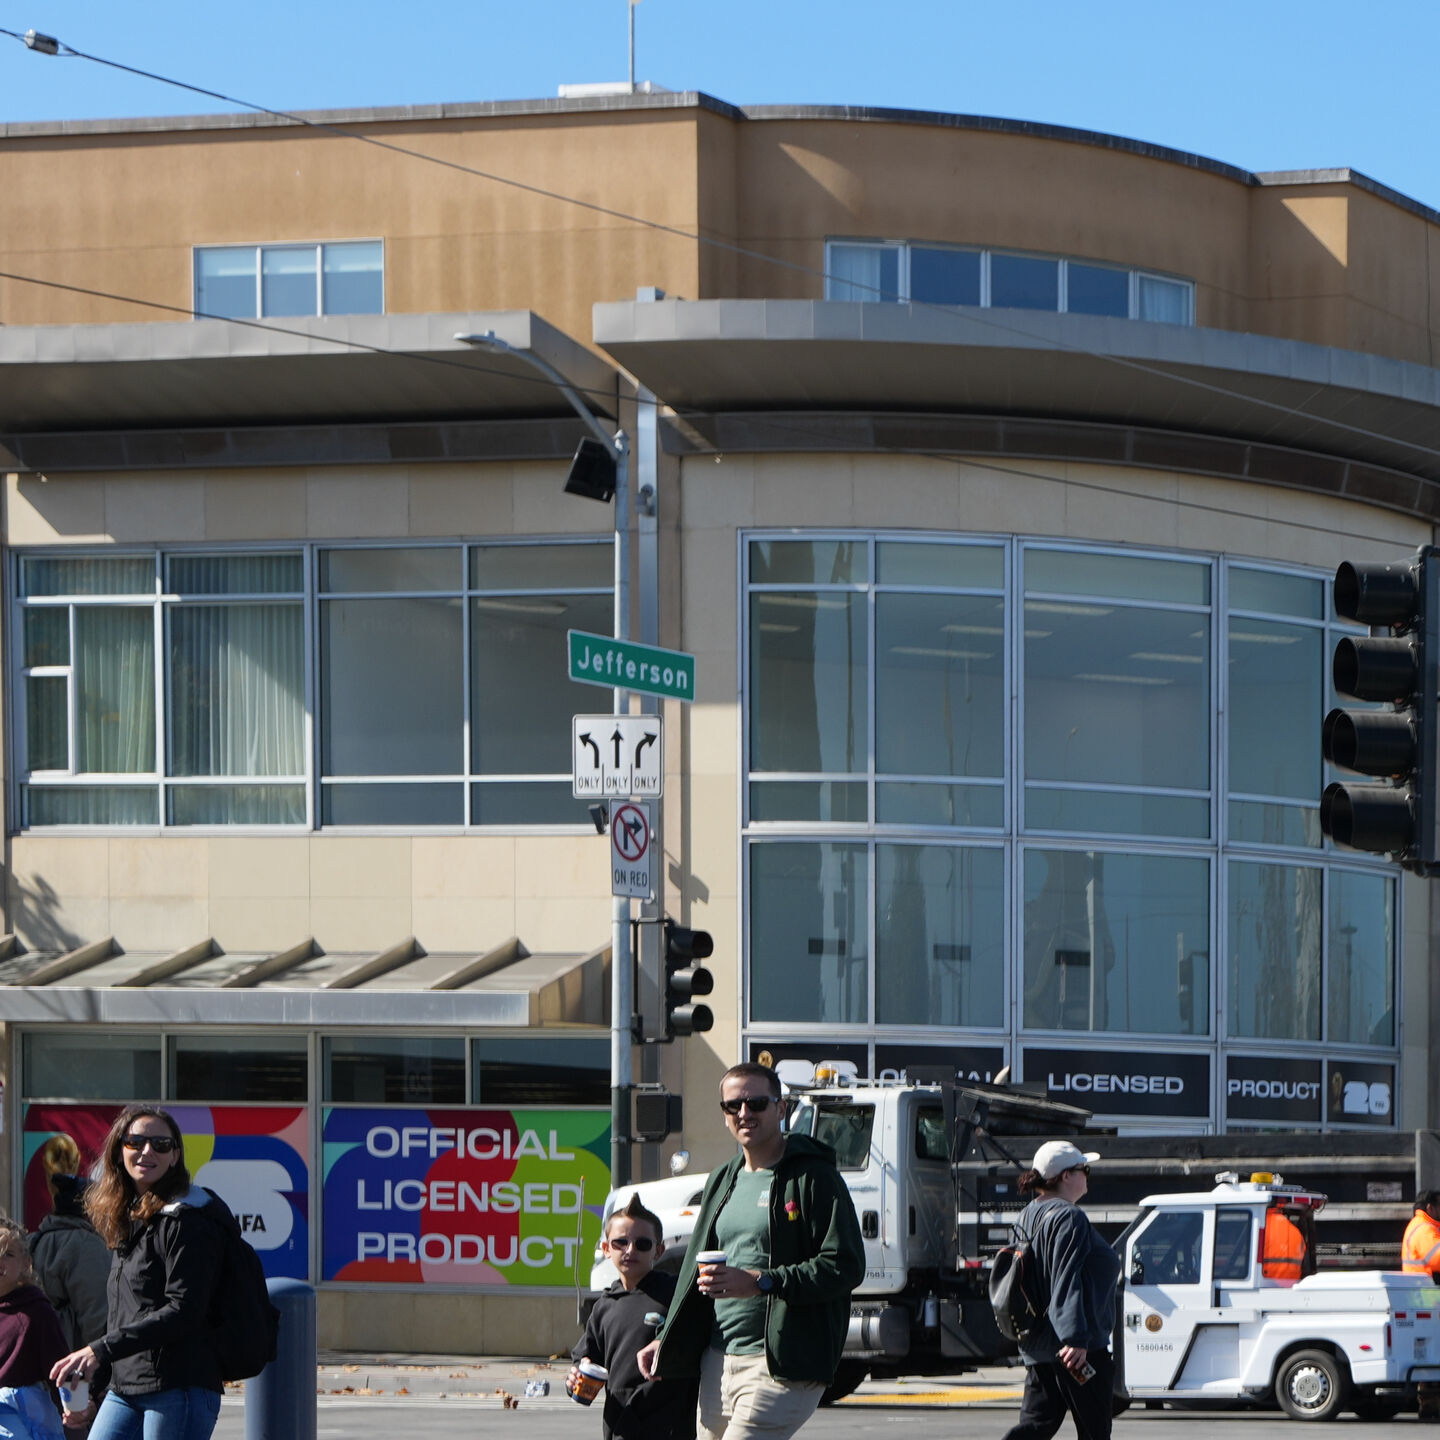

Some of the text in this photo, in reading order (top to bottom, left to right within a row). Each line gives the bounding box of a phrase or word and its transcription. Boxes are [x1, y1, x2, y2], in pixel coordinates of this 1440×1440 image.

[577, 645, 688, 690] Jefferson
[578, 776, 657, 789] ONLY ONLY ONLY
[614, 869, 648, 887] ON RED
[1048, 1072, 1185, 1095] LICENSED
[1227, 1078, 1321, 1100] PRODUCT
[366, 1125, 575, 1160] OFFICIAL
[357, 1178, 582, 1214] LICENSED
[357, 1231, 584, 1268] PRODUCT
